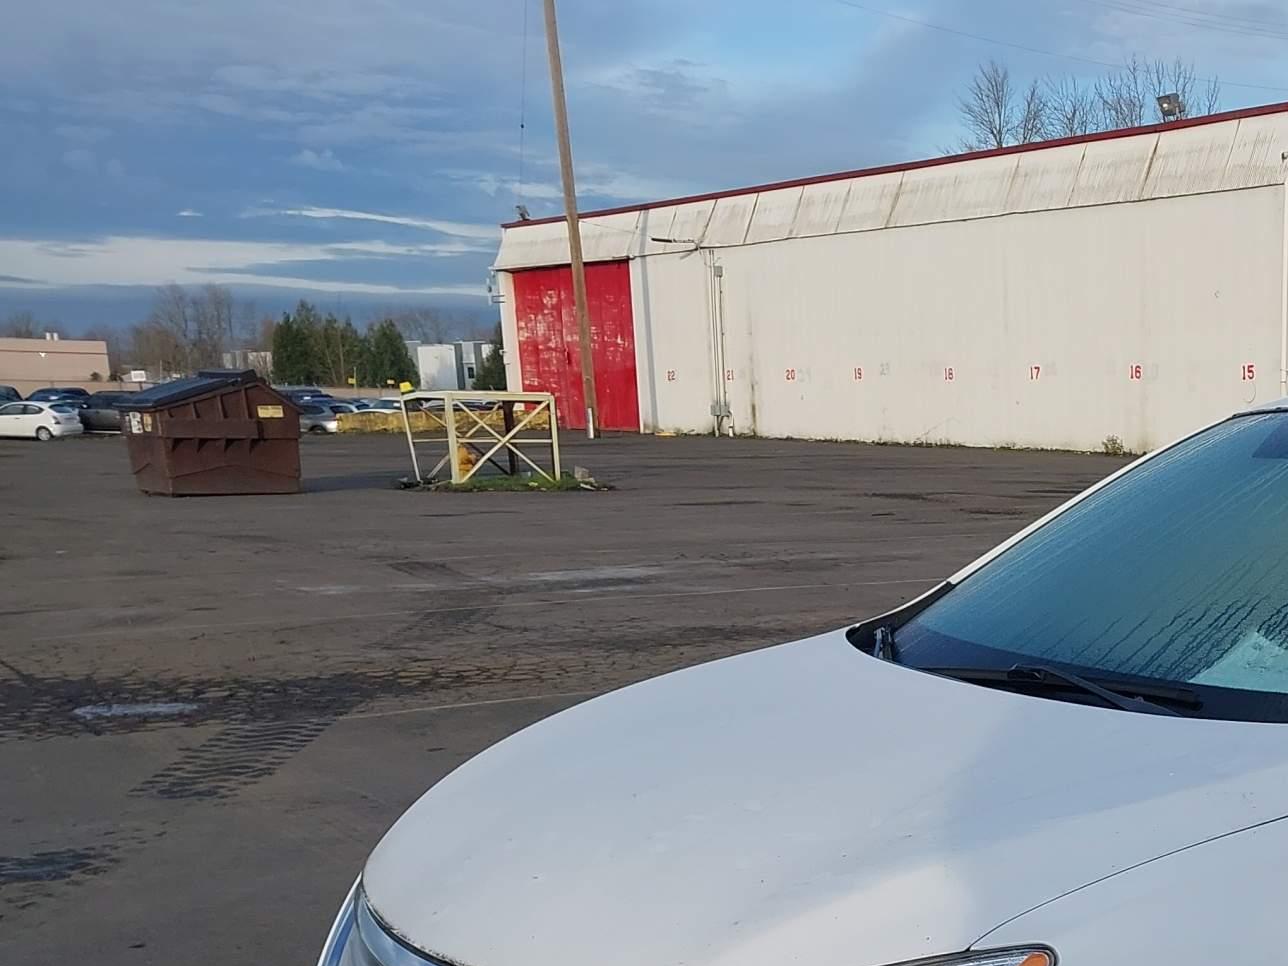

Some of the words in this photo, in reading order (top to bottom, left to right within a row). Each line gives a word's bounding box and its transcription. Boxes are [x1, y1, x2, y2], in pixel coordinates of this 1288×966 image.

[726, 369, 735, 381] 21
[785, 368, 796, 381] 20
[853, 367, 863, 380] 19
[944, 367, 954, 381] 18
[1029, 366, 1041, 380] 17
[1129, 364, 1142, 380] 16
[1242, 364, 1255, 380] 15
